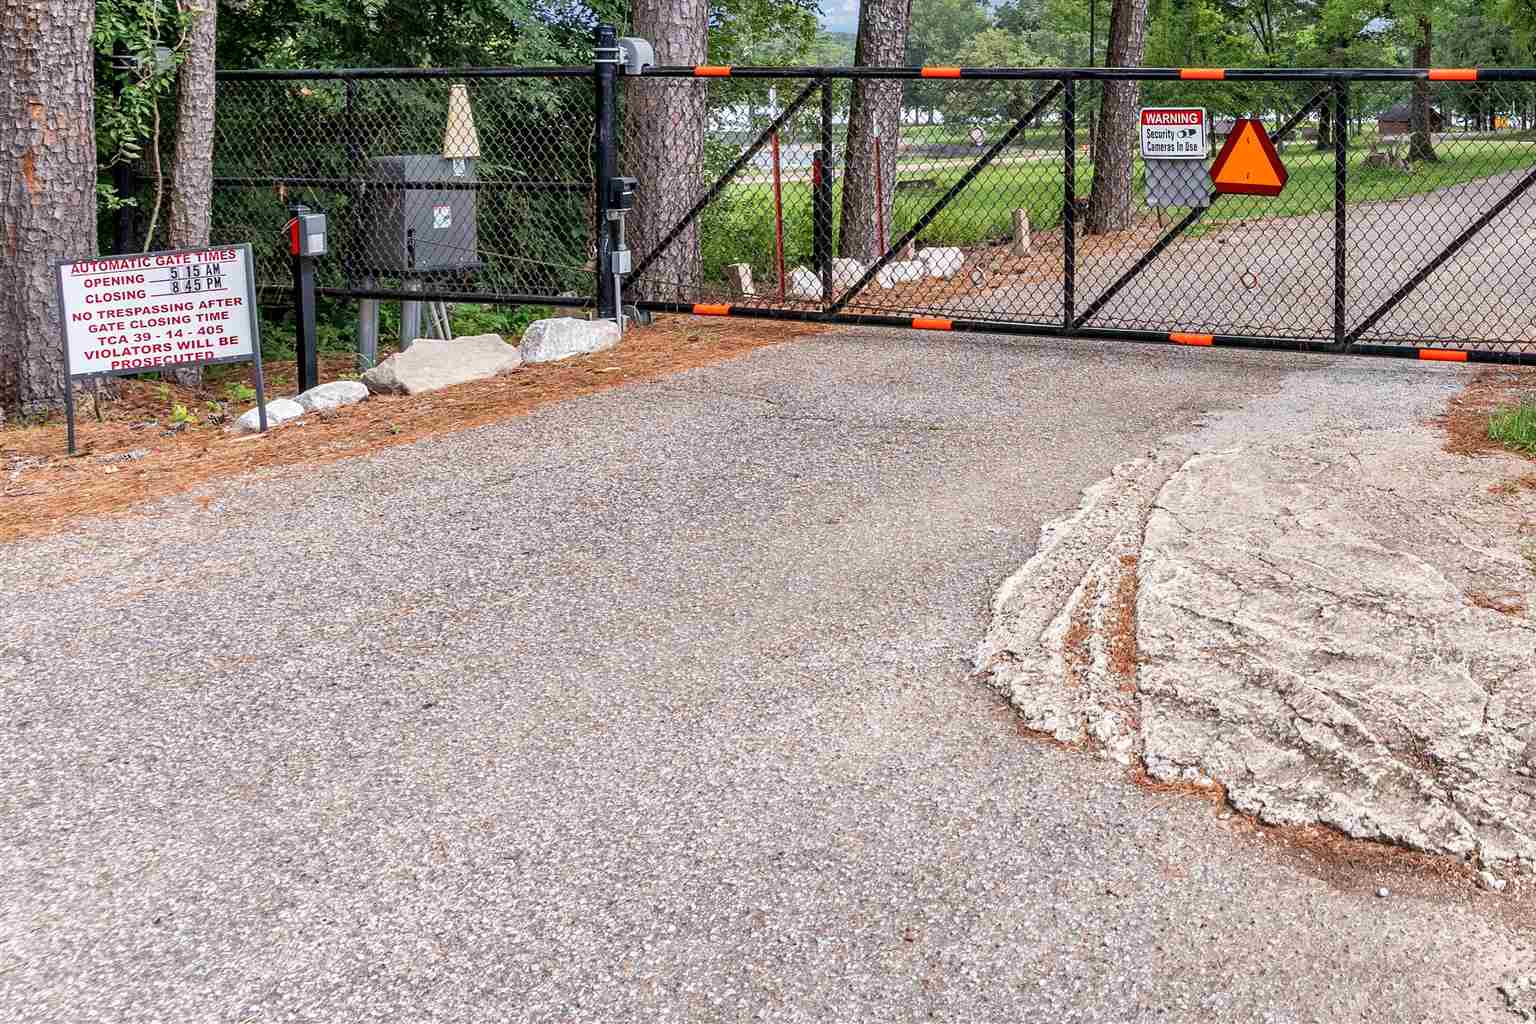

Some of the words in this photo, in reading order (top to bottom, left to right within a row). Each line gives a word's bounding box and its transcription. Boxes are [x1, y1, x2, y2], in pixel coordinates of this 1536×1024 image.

[1145, 113, 1198, 124] WARNING
[1146, 128, 1175, 141] Security
[1147, 141, 1175, 152] Cameras
[1177, 141, 1183, 151] In
[1185, 141, 1198, 152] Use
[71, 258, 151, 274] AUTOMATIC
[156, 255, 191, 266] GATE
[196, 249, 237, 262] TIMES
[84, 275, 145, 288] OPENING
[170, 267, 178, 279] 5
[187, 265, 200, 277] 15
[206, 263, 221, 276] AM
[85, 290, 146, 304] CLOSING
[172, 282, 180, 294] 8
[185, 280, 201, 292] 45
[207, 277, 222, 289] PM
[72, 311, 93, 322] NO
[98, 302, 194, 320] TRESPASSING
[199, 297, 243, 310] AFTER
[89, 322, 126, 334] GATE
[130, 315, 191, 329] CLOSING
[196, 311, 230, 322] TIME
[98, 334, 129, 346] TCA
[134, 332, 151, 343] 39
[167, 329, 184, 340] 14
[198, 324, 224, 336] 405
[84, 340, 173, 361] VIOLATORS
[178, 336, 214, 352] WILL
[219, 335, 239, 347] BE
[111, 350, 215, 370] PROSECUTED
